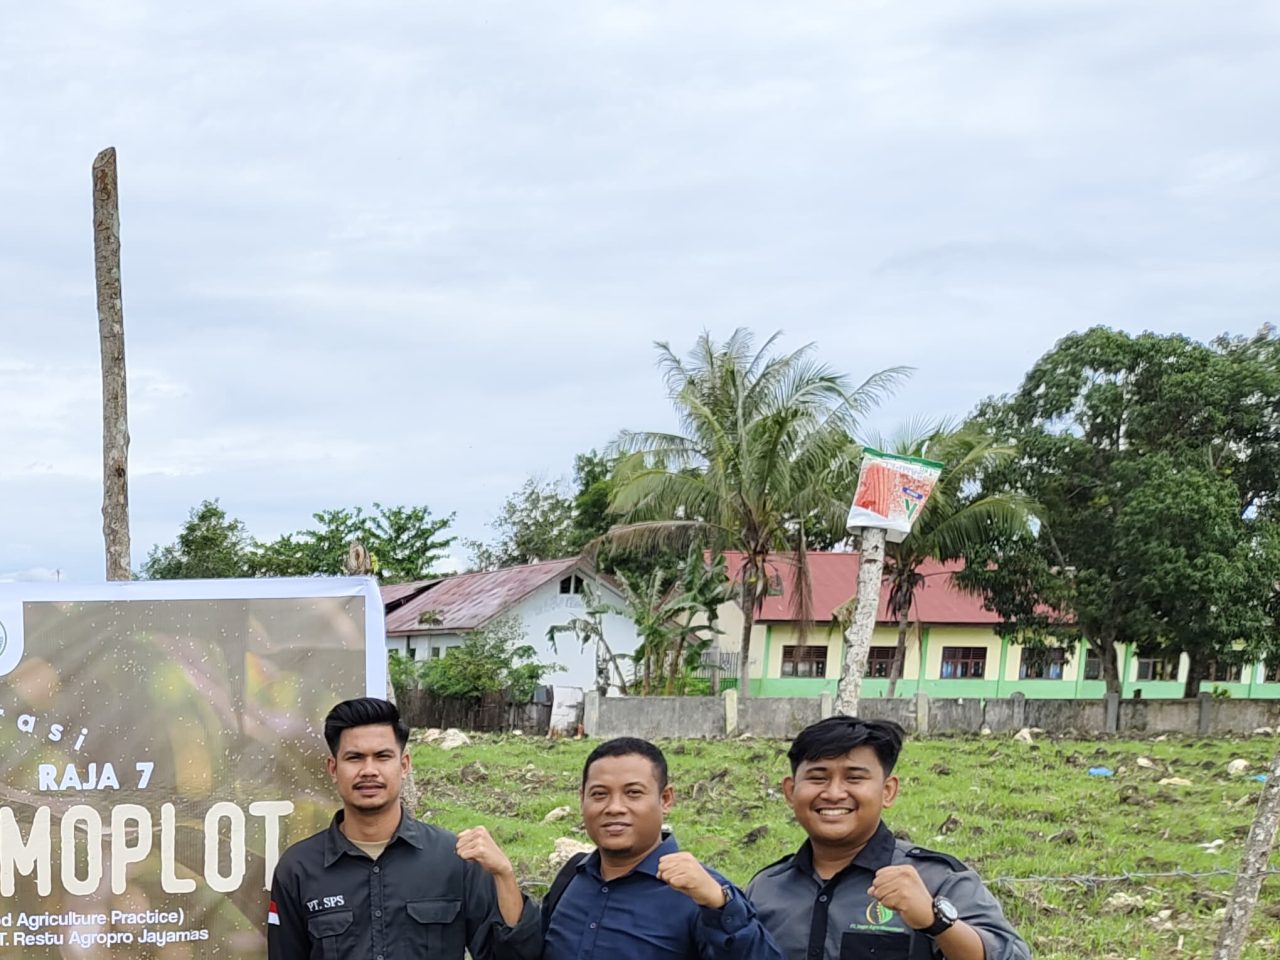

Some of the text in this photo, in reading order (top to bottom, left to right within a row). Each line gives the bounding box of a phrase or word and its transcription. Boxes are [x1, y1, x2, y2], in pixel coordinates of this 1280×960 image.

[38, 762, 156, 791] RAJA 7
[306, 895, 345, 912] PT. SPS
[16, 911, 107, 930] Agriculture
[111, 908, 184, 926] Practice)
[13, 931, 64, 946] Restu
[68, 930, 133, 949] Agropro
[137, 929, 209, 946] Jayamas
